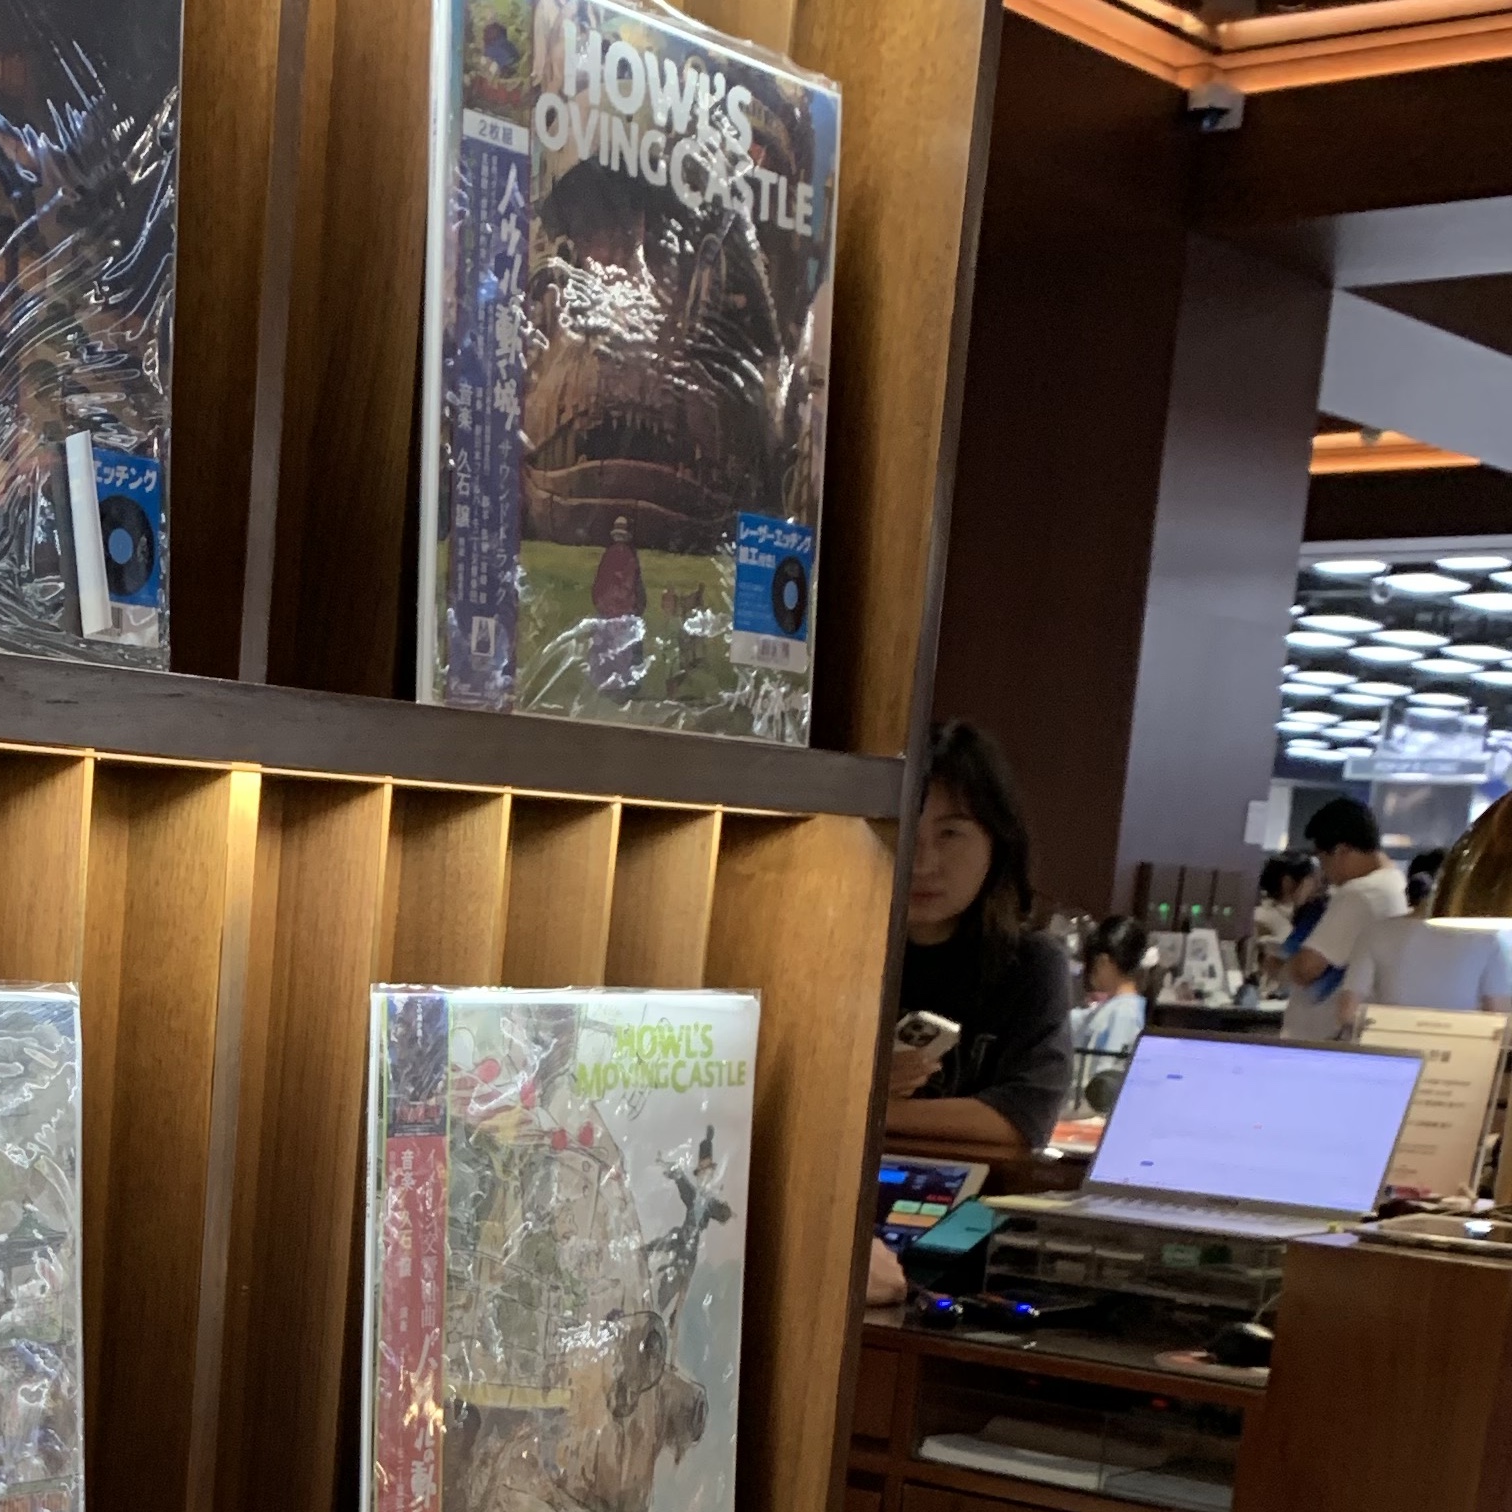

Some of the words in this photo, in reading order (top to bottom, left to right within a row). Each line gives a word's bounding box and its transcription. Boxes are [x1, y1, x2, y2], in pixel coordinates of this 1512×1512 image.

[535, 92, 668, 187] OVING
[670, 136, 815, 237] CASTLE
[456, 447, 473, 496] 久石
[615, 1021, 714, 1061] HOWL'S
[576, 1061, 670, 1098] MOVING
[671, 1059, 748, 1094] CASTLE
